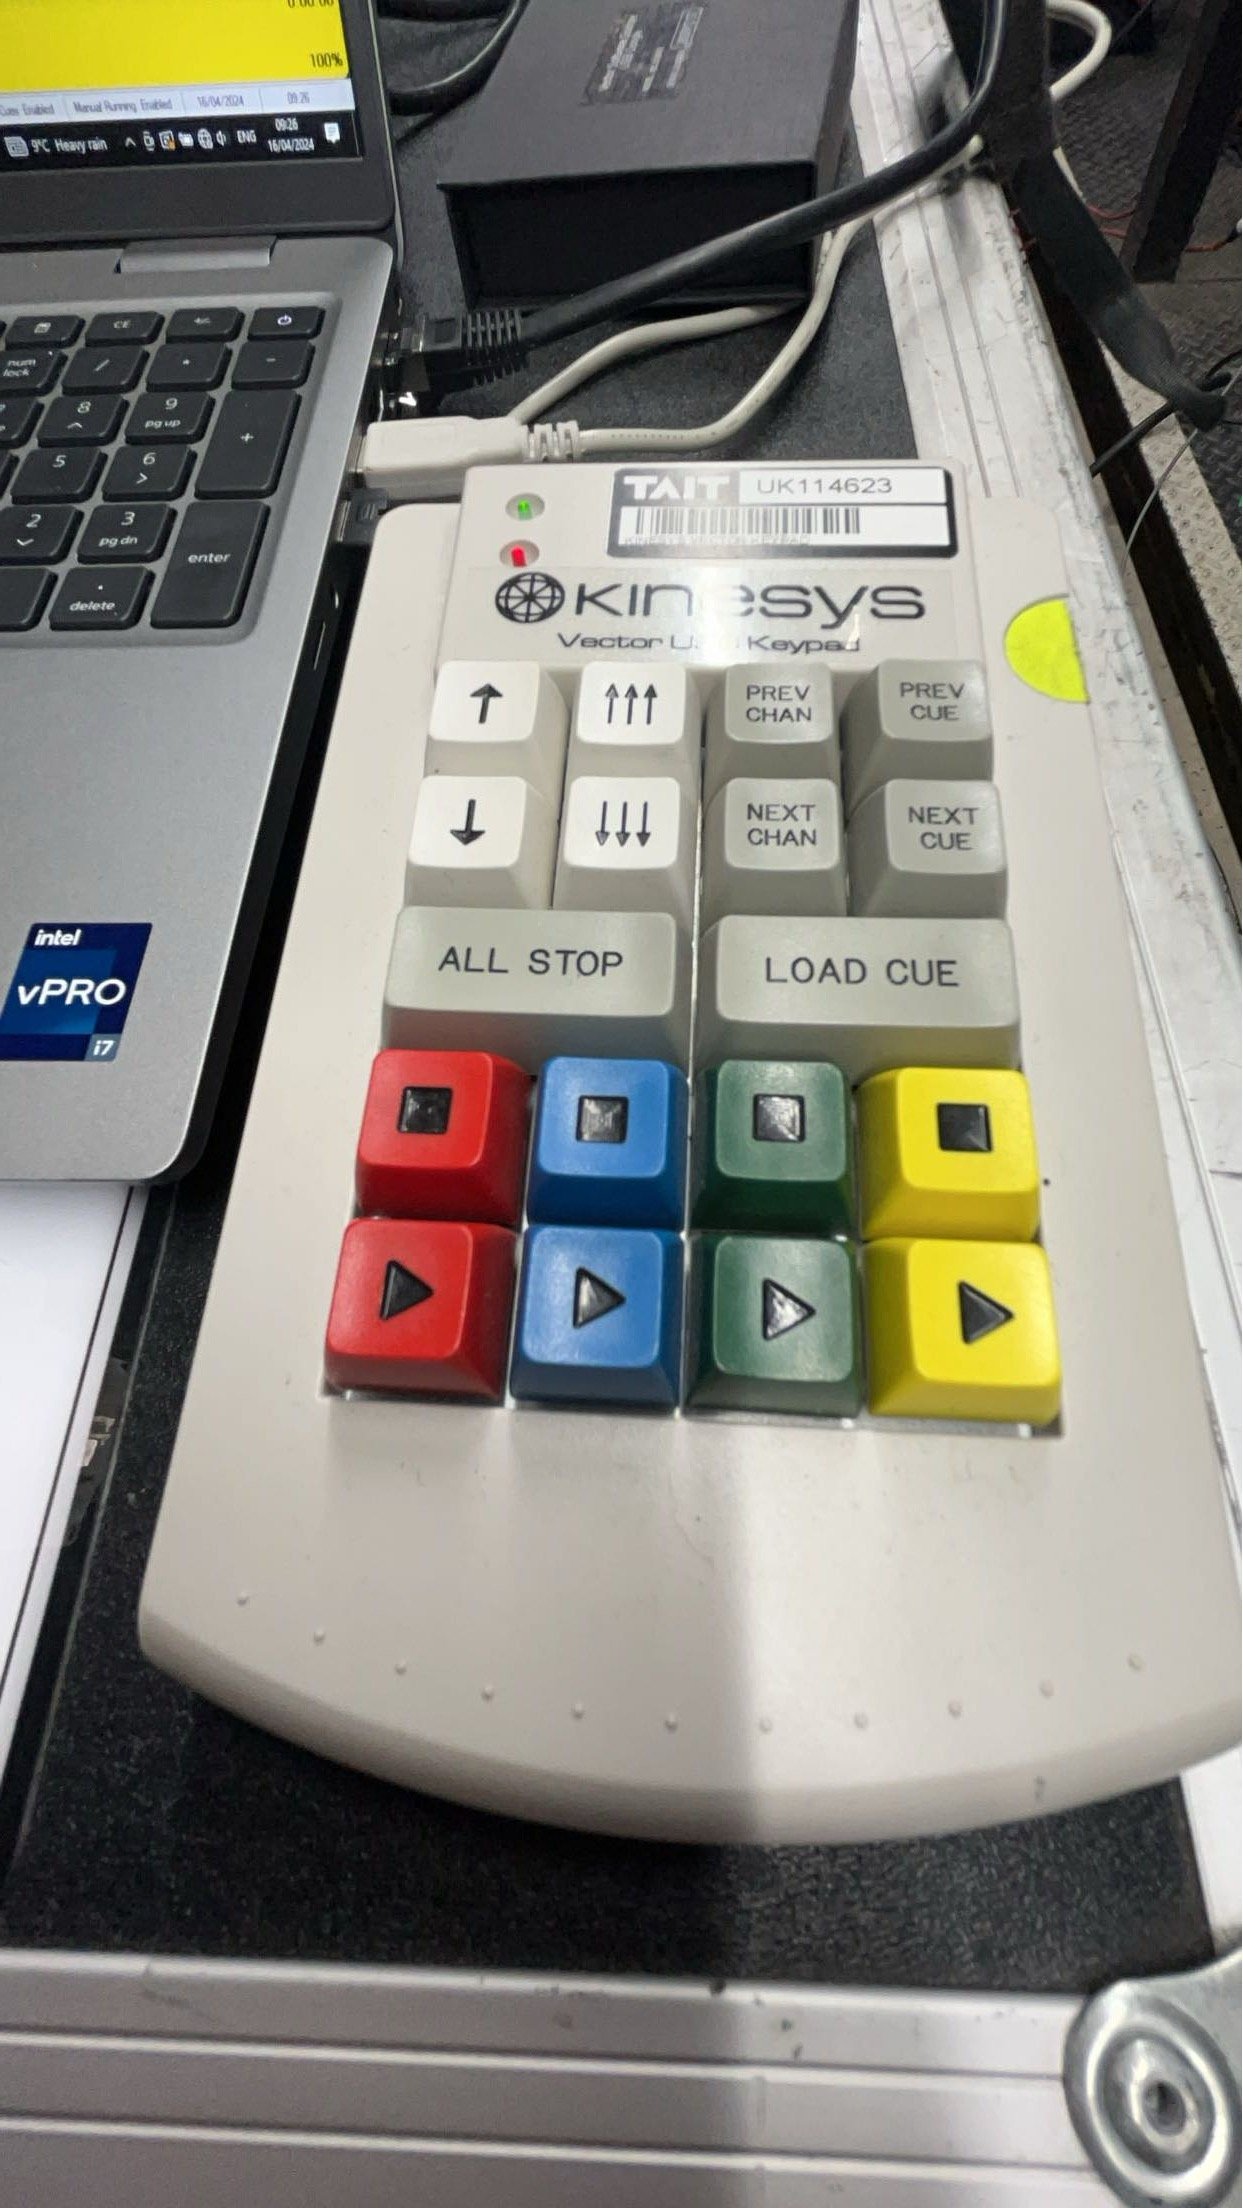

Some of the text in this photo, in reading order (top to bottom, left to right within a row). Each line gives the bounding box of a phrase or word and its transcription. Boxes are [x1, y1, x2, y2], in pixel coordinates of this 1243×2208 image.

[310, 52, 343, 68] 100%
[197, 95, 244, 107] 16/04/2024
[275, 117, 298, 131] 09:26
[237, 130, 257, 143] ENG
[54, 138, 86, 154] Heavy
[87, 136, 108, 150] rain
[267, 137, 315, 153] 16/04/2024
[8, 359, 36, 367] num
[3, 368, 30, 377] lock
[77, 401, 92, 414] 8
[165, 397, 178, 410] 9
[145, 419, 181, 429] pg up
[52, 454, 67, 468] 5
[142, 452, 156, 466] 6
[624, 475, 730, 499] TAIT
[756, 477, 893, 495] UK114623
[26, 513, 42, 528] 2
[121, 511, 136, 526] 3
[98, 535, 138, 548] pg dn
[187, 552, 231, 564] enter
[69, 601, 116, 612] delete
[557, 632, 664, 649] Vector
[746, 684, 811, 702] PREV
[899, 682, 965, 700] PREV
[745, 706, 812, 723] CHAN
[908, 704, 959, 721] CUE
[746, 803, 816, 821] NEXT
[908, 806, 979, 825] NEXT
[746, 828, 817, 847] CHAN
[919, 832, 972, 852] CUE
[34, 929, 82, 946] intel
[438, 946, 624, 978] ALL STOP
[765, 957, 959, 987] LOAD CUE
[17, 978, 127, 1006] vPRO
[93, 1040, 115, 1056] i7
